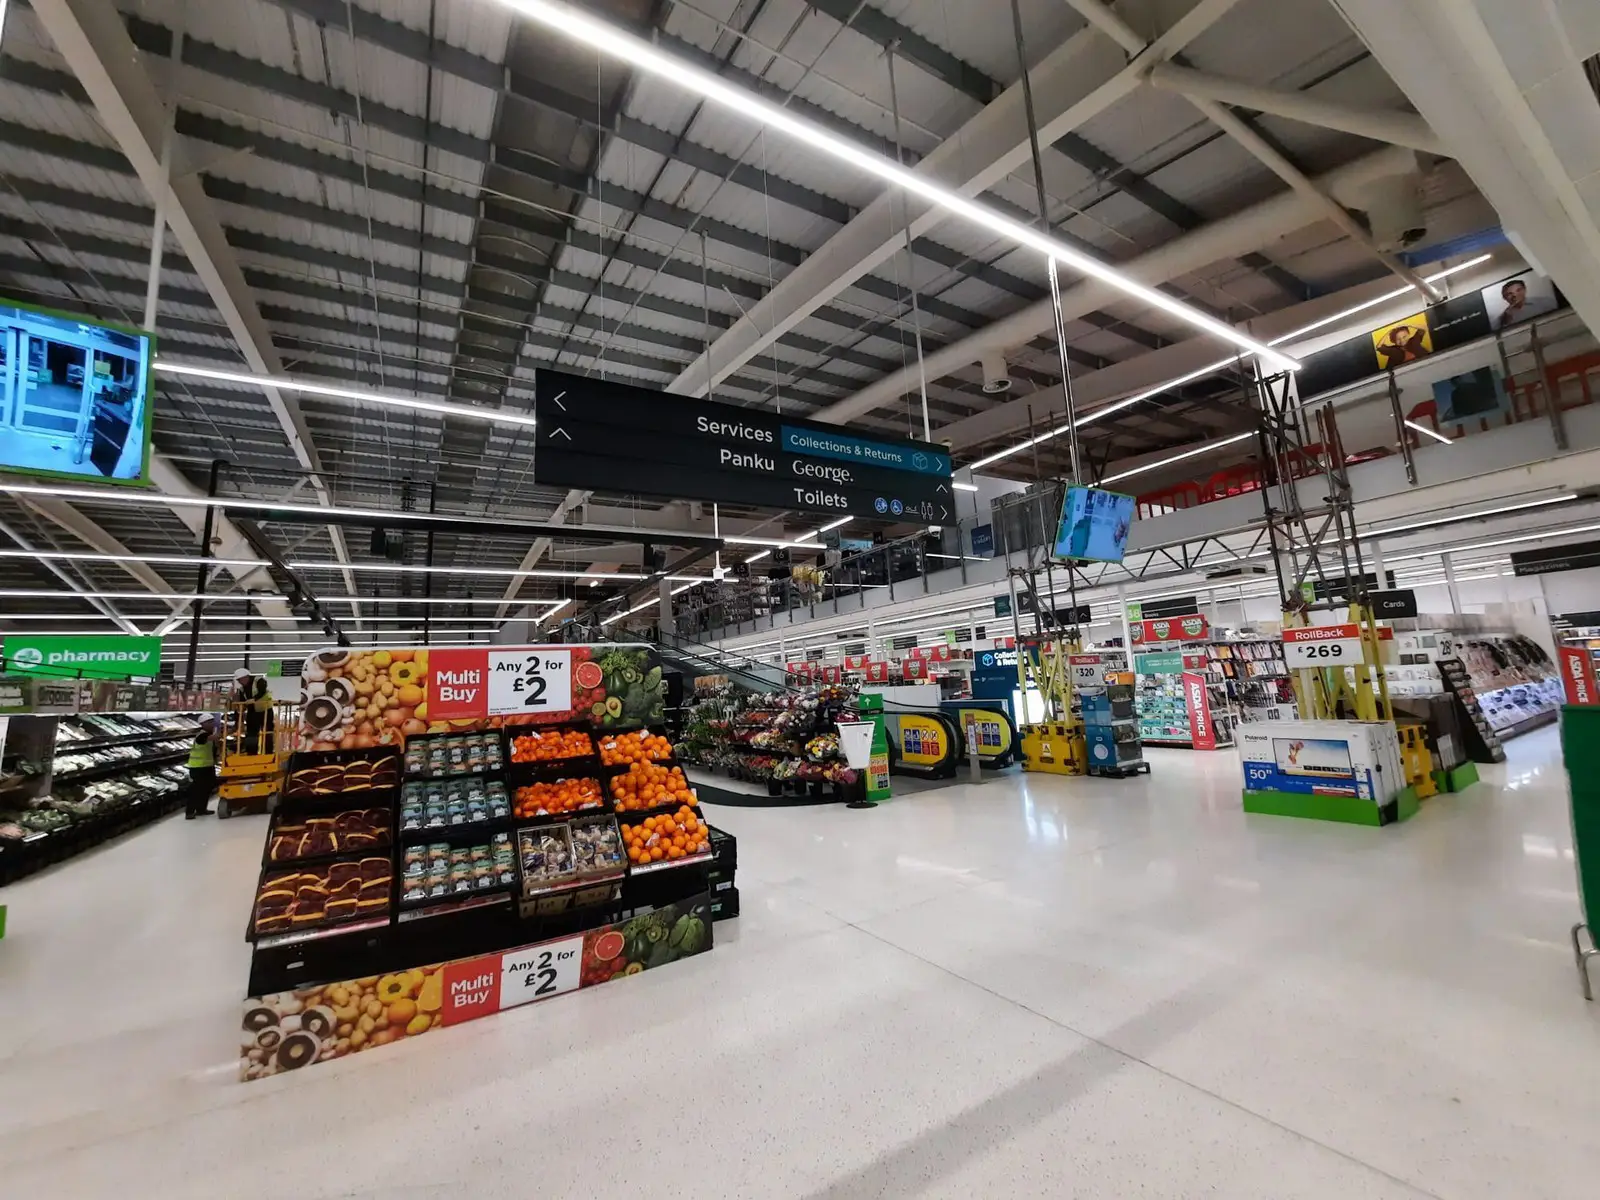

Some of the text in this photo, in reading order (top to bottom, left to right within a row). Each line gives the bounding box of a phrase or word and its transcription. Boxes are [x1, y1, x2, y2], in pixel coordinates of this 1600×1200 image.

[697, 417, 774, 443] Services
[720, 449, 775, 471] Panku
[790, 434, 902, 464] Collections & Returns
[792, 460, 854, 485] George.
[793, 488, 848, 508] Toilets
[1295, 628, 1344, 641] RollBack
[48, 650, 150, 665] pharmacy
[1298, 644, 1342, 658] £269
[496, 656, 563, 675] Any 2 for
[436, 669, 480, 686] Multi
[1568, 654, 1589, 703] ASDA PRICE
[440, 686, 477, 703] Buy
[513, 676, 547, 705] £2
[1190, 682, 1201, 709] ASDA
[1195, 710, 1206, 737] PRICE
[1249, 769, 1272, 780] 50"
[508, 950, 575, 973] Any 2 for
[451, 972, 494, 995] Multi
[524, 968, 557, 996] £2
[454, 989, 489, 1008] Buy
